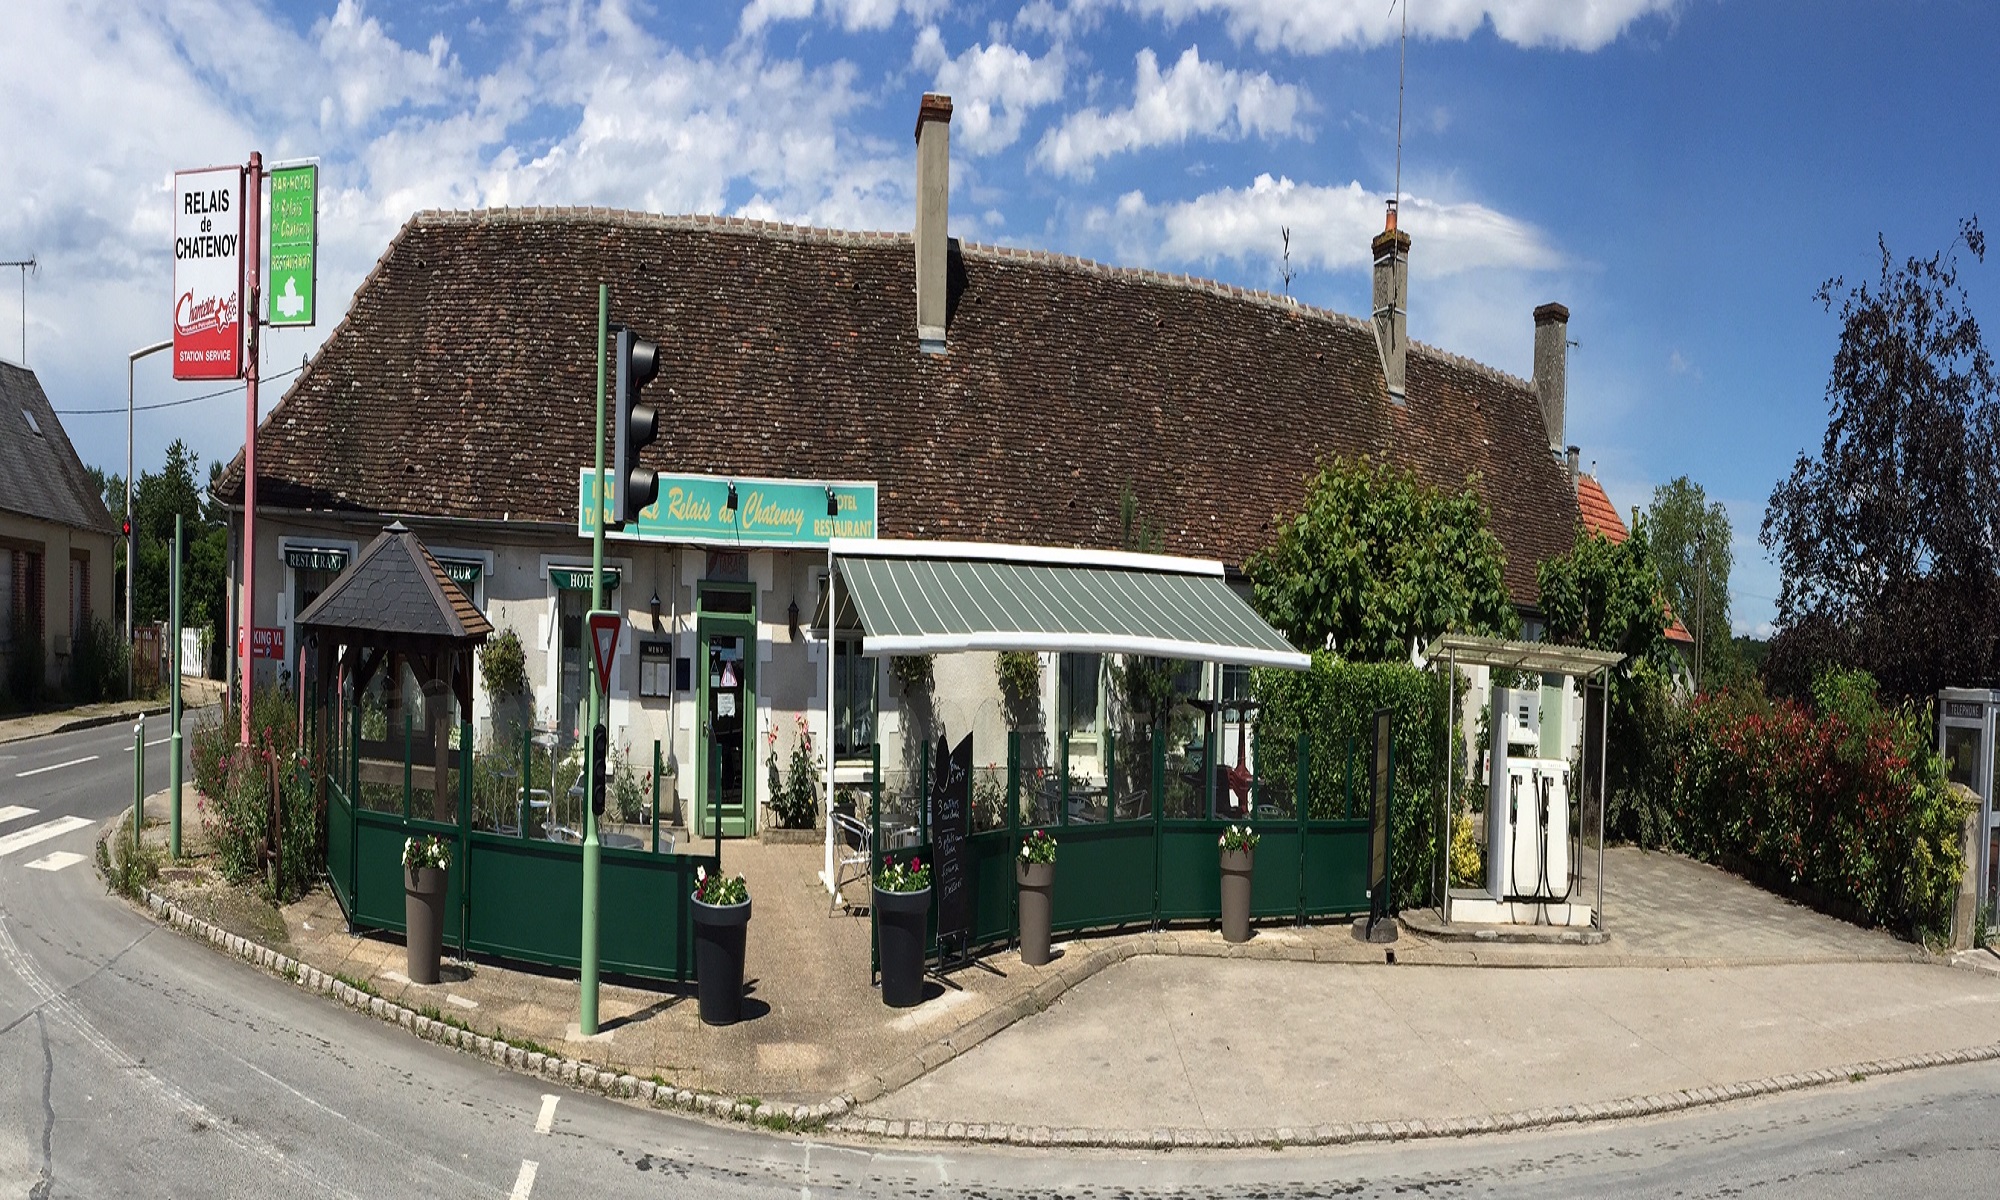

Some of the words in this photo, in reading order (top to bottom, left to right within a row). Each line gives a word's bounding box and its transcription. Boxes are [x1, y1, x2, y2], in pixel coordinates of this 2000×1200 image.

[185, 189, 229, 214] RELAIS
[200, 216, 212, 232] de
[175, 234, 238, 260] CHATENOY
[180, 350, 204, 362] STATION
[206, 349, 231, 361] SERVICE
[667, 487, 712, 521] Relais
[742, 491, 805, 535] Chatenoy
[837, 495, 857, 511] OTEL
[813, 518, 872, 537] RESTAURANT
[290, 553, 342, 569] RESTAURANT
[239, 629, 272, 646] PKING
[273, 631, 283, 646] VL
[648, 645, 664, 654] MENU
